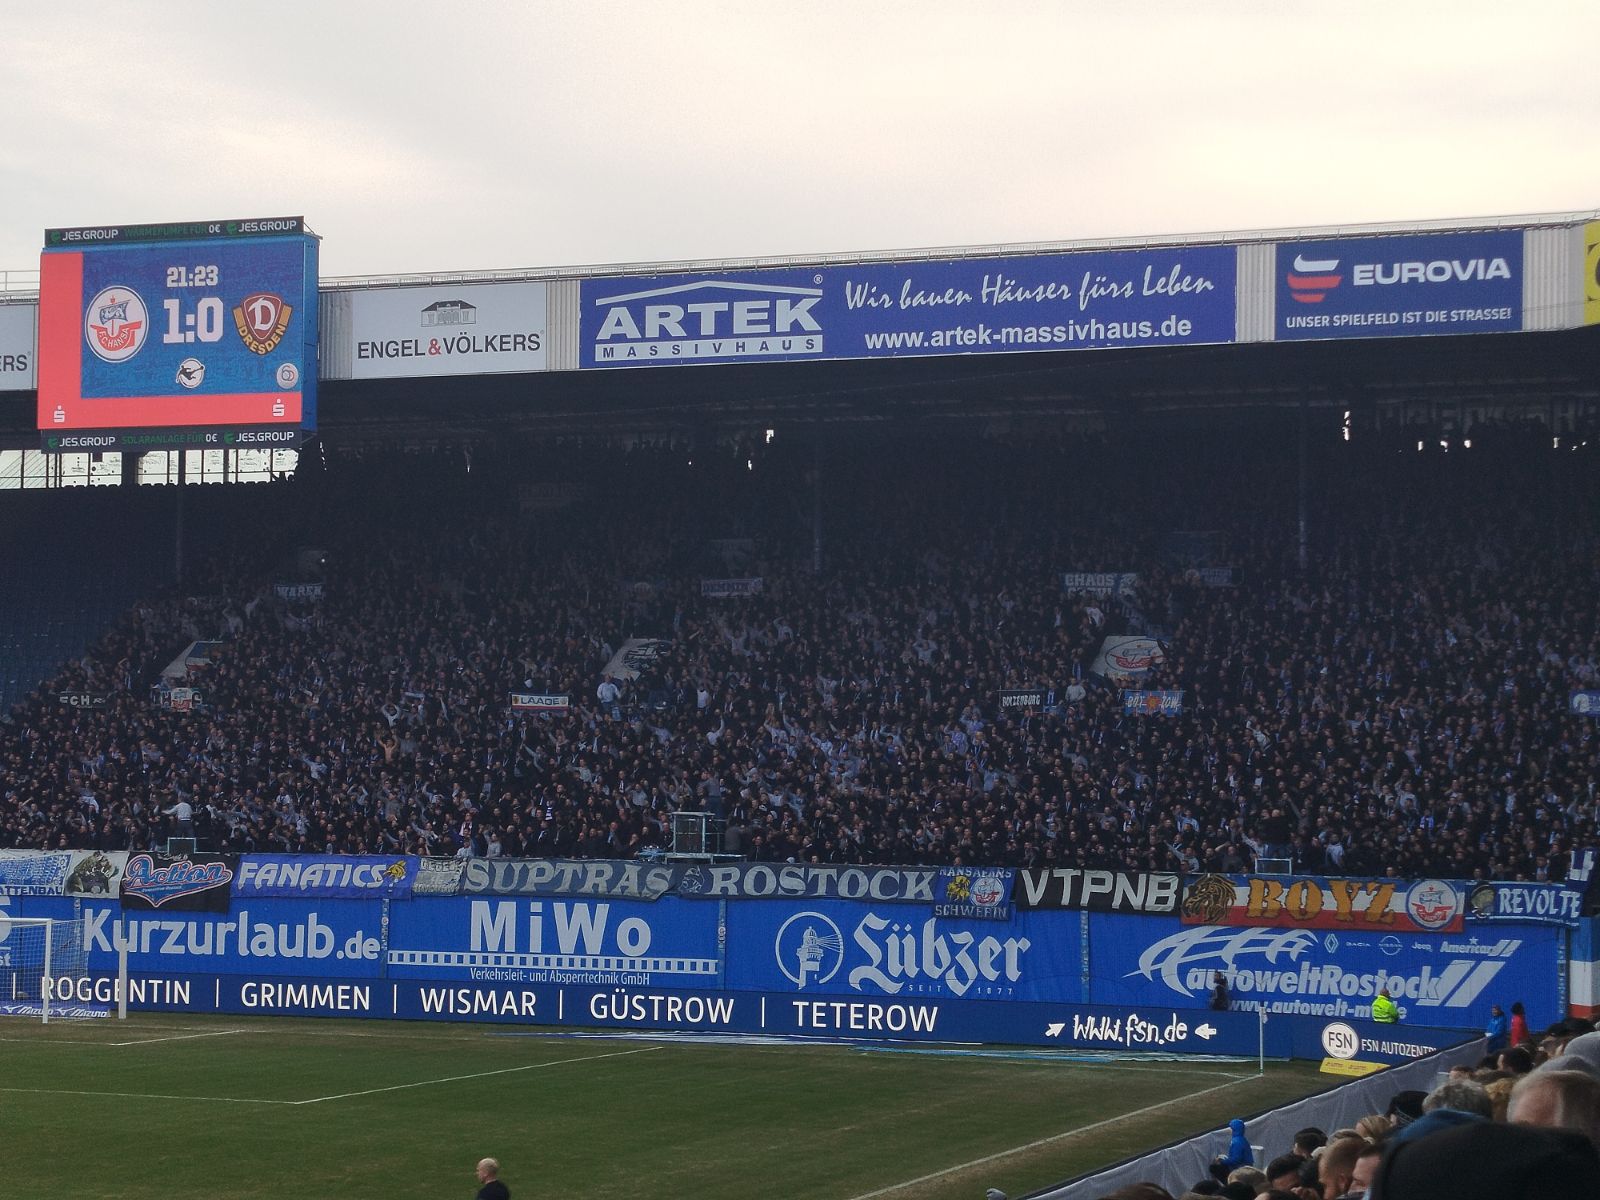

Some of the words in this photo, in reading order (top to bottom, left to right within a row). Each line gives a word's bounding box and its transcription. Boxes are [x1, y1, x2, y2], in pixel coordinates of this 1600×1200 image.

[62, 229, 119, 241] JES.GROUP
[208, 223, 221, 234] 0€
[238, 220, 297, 233] JES.GROUP
[166, 265, 219, 288] 21:23
[1353, 258, 1511, 286] EUROVIA
[845, 279, 893, 310] Wir
[898, 278, 973, 310] bauen
[980, 274, 1071, 307] Häuser
[1078, 271, 1133, 312] fürs
[1140, 263, 1214, 297] Leben
[163, 297, 224, 344] 1:0
[596, 298, 823, 341] ARTEK
[864, 314, 1193, 349] www.artek-massivhaus.de
[1286, 314, 1329, 328] UNSER
[1333, 313, 1398, 327] SPIELFELD
[1402, 311, 1421, 324] IST
[1425, 310, 1447, 323] DIE
[1450, 308, 1512, 322] STRASSE!
[238, 324, 286, 355] DRESDEN
[357, 339, 426, 359] ENGEL
[443, 331, 541, 355] VÖLKERS
[602, 339, 815, 359] MASSIVHAUS
[59, 436, 116, 447] JES.GROUP
[205, 433, 218, 443] 0€
[235, 431, 294, 442] JES.GROUP
[121, 856, 233, 886] Action
[237, 861, 387, 890] FANATICS
[464, 859, 675, 899] SUPTRAS
[704, 866, 937, 900] ROSTOCK
[1021, 869, 1179, 912] VTPNB
[1247, 878, 1397, 924] BOYZ
[1498, 887, 1582, 918] REVOLTE
[935, 904, 1007, 918] SCHWERIN
[470, 900, 651, 957] MiWo
[849, 912, 1031, 997] Lübzer
[470, 967, 528, 982] Verkehrsleit-
[529, 970, 548, 982] und
[549, 970, 619, 985] Absperrtechnik
[620, 973, 650, 986] GmbH
[908, 984, 942, 993] SEIT
[977, 987, 1013, 995] 1877
[241, 982, 370, 1010] GRIMMEN
[420, 988, 537, 1017] WISMAR
[590, 989, 734, 1023] GÜSTROW
[792, 1001, 938, 1032] TETEROW
[1328, 1031, 1353, 1049] FSN
[1361, 1039, 1379, 1052] FSN
